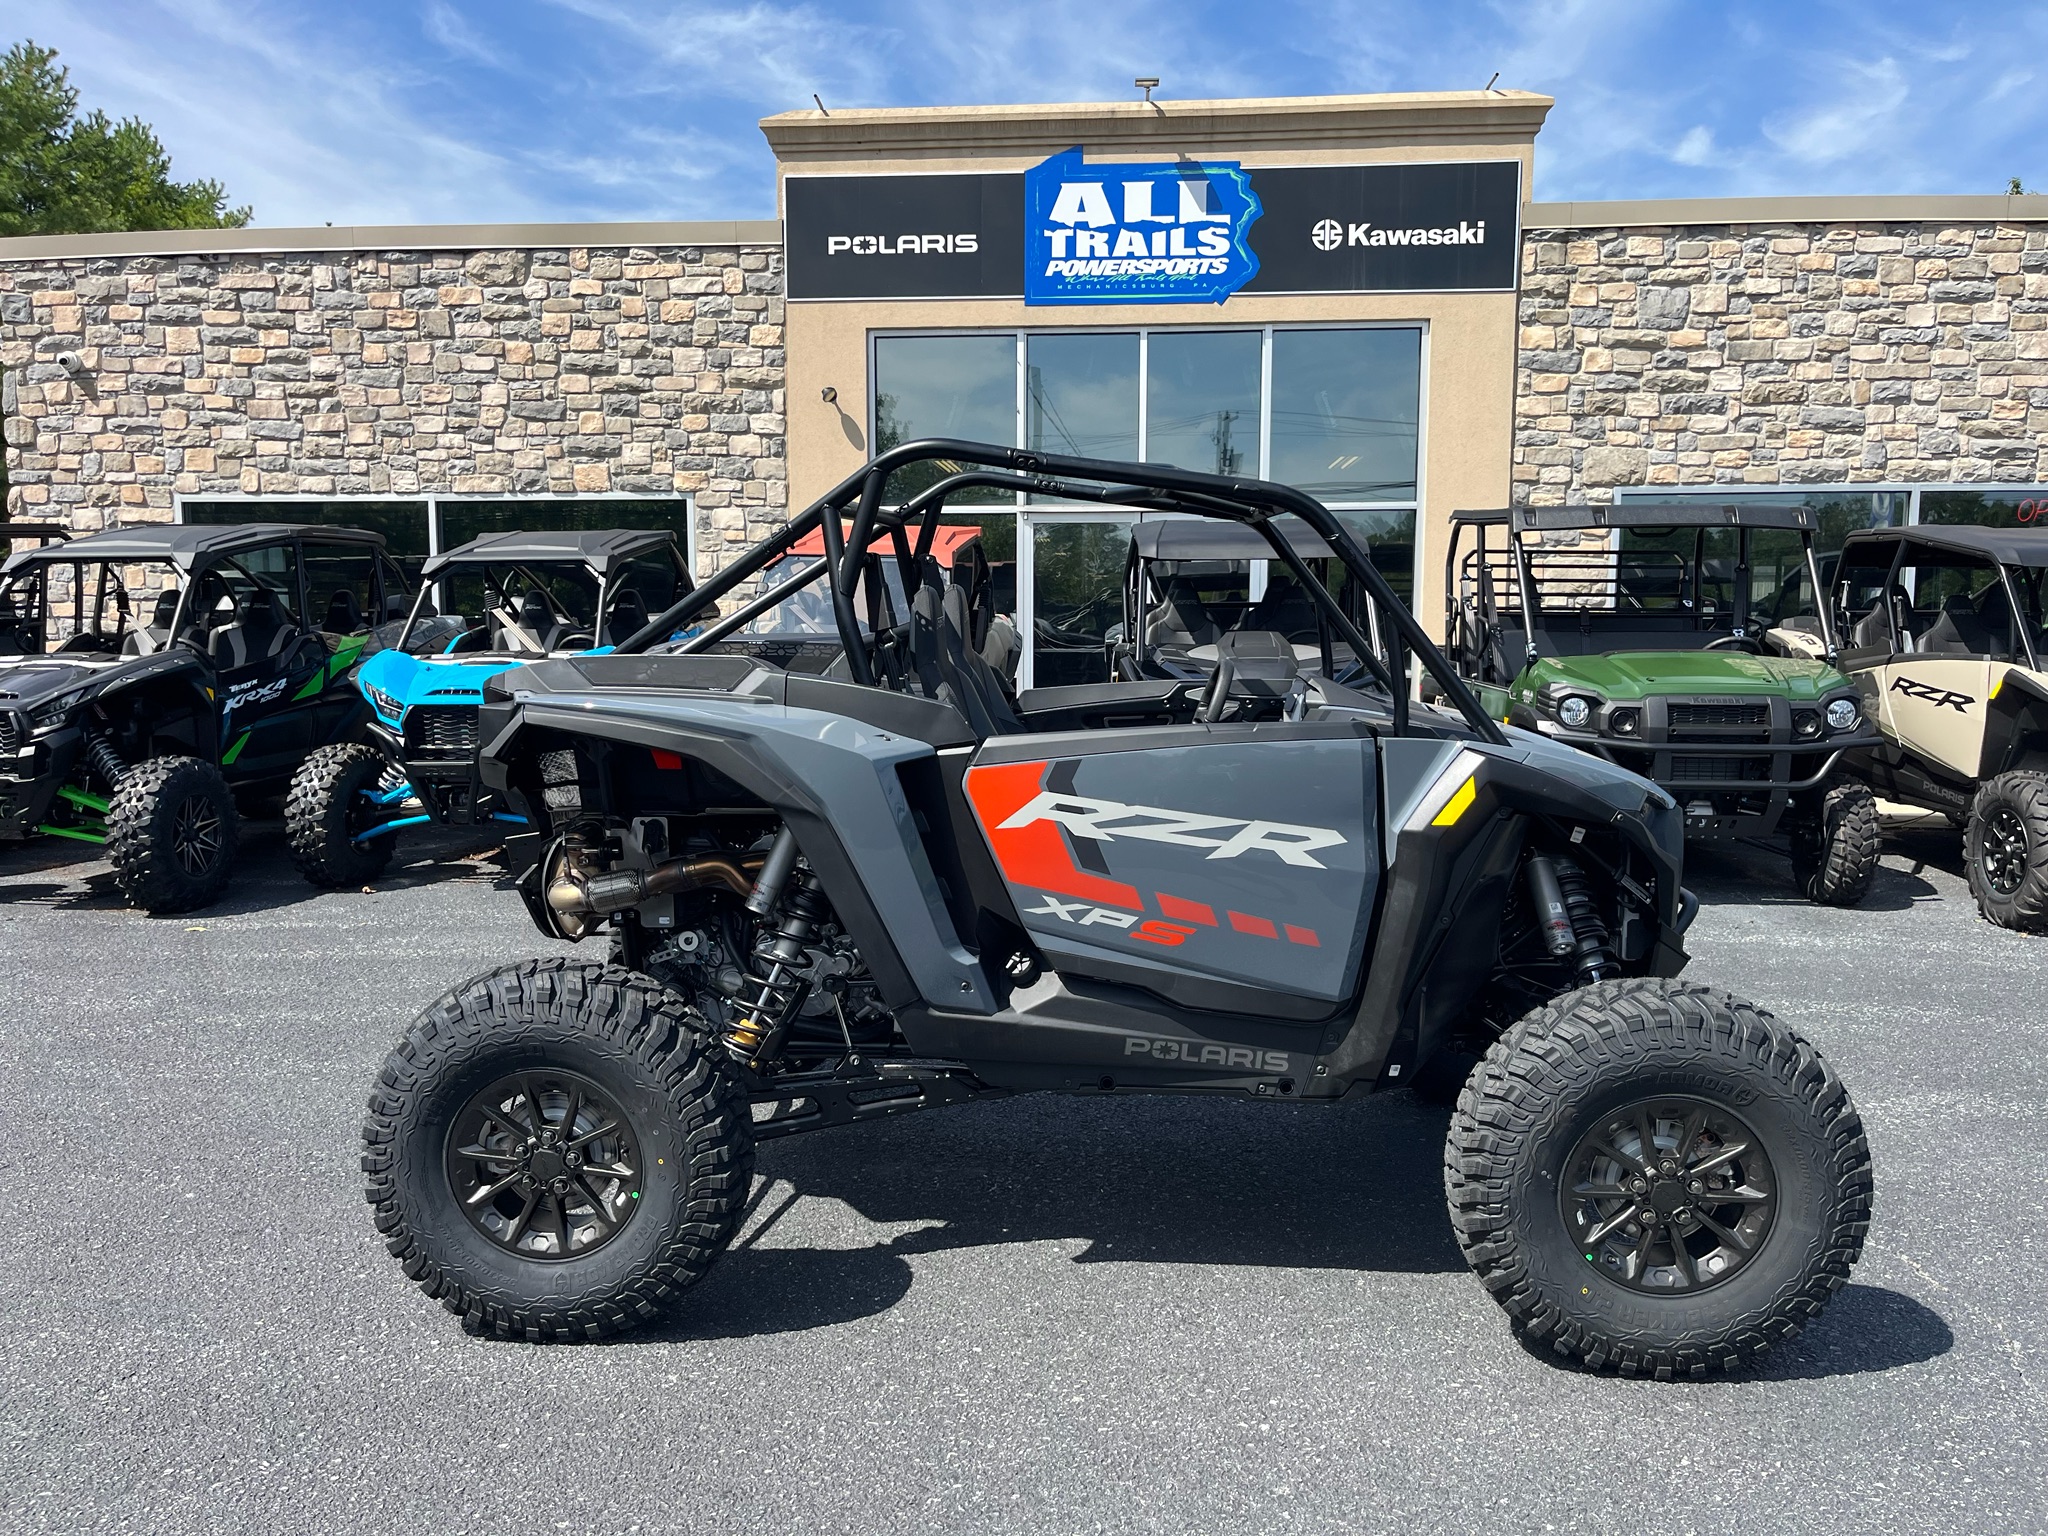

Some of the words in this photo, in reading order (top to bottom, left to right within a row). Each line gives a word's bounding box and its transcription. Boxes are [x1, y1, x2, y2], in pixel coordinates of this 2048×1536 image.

[1049, 180, 1231, 228] ALL
[828, 234, 979, 255] POLARIS
[1044, 227, 1231, 258] TRAILS
[1348, 221, 1485, 247] Kawasaki
[1045, 258, 1230, 277] POWERSPORTS
[223, 678, 287, 714] KRX4
[1890, 676, 1976, 714] RZR
[1923, 781, 1965, 805] POLARIS
[995, 791, 1348, 869] RZR
[1124, 1037, 1289, 1072] POLARIS
